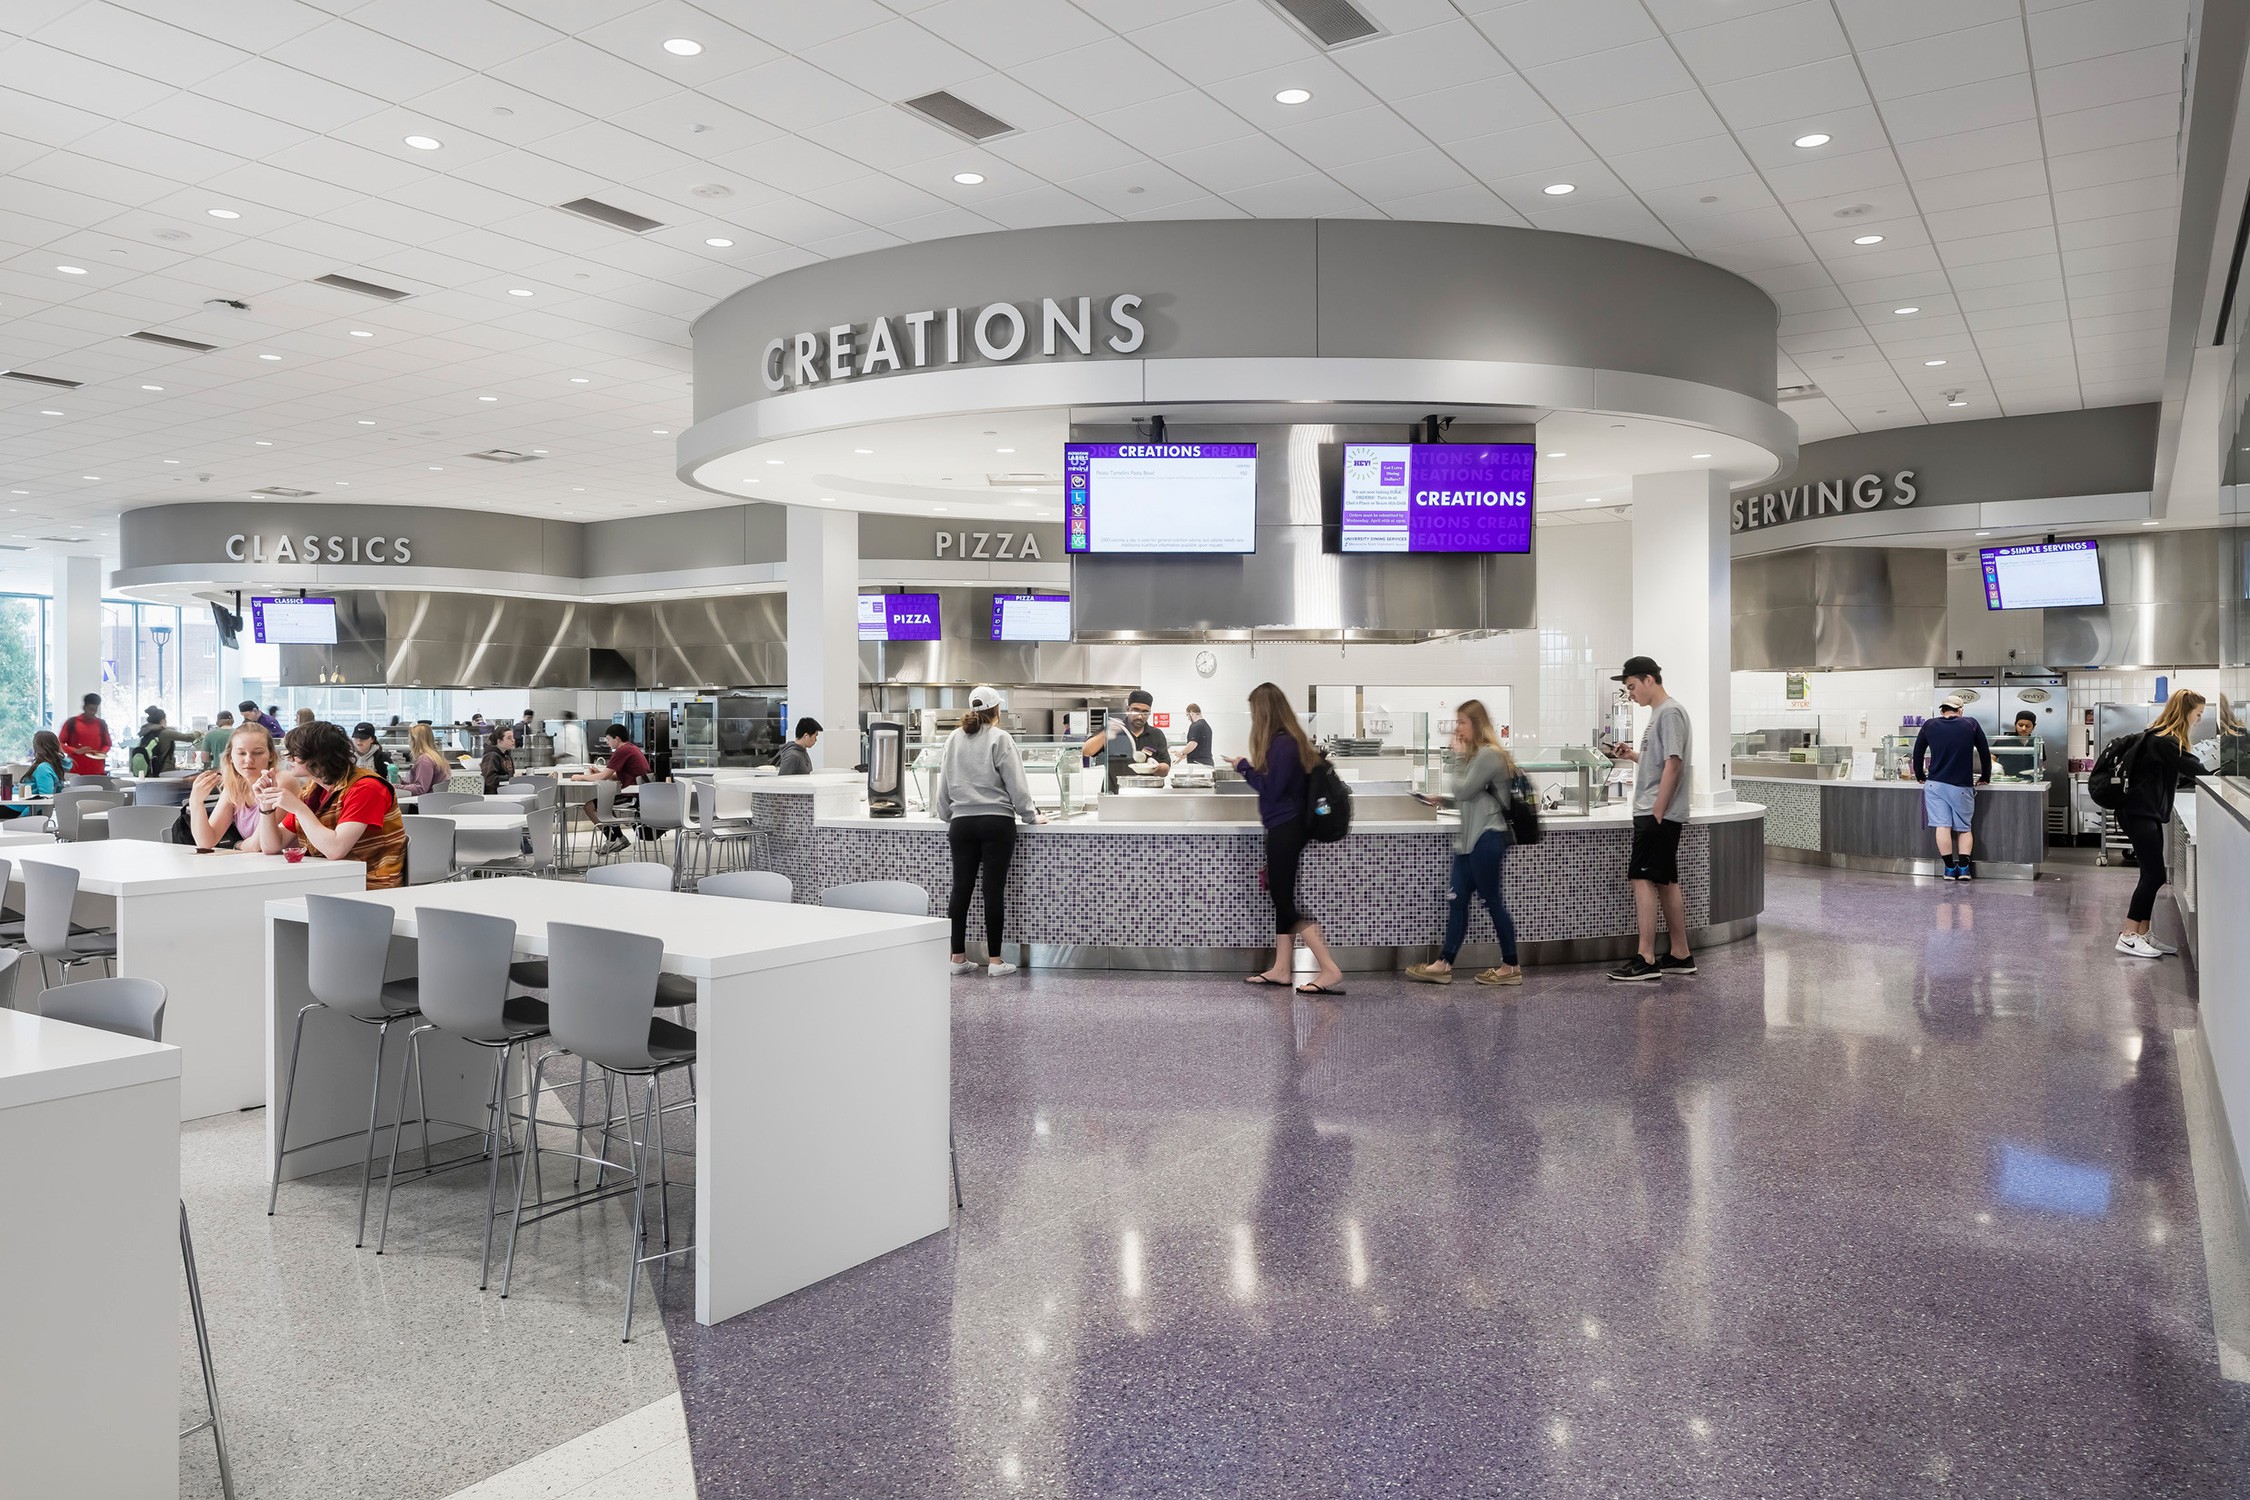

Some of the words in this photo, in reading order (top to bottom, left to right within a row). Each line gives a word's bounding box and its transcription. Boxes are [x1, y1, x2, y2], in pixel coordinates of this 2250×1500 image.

[761, 294, 1145, 392] CREATIONS
[1118, 445, 1201, 457] CREATIONS
[1202, 446, 1256, 457] CREATI
[1416, 491, 1527, 506] CREATIONS
[1732, 470, 1917, 530] SERVINGS
[225, 534, 411, 564] CLASSICS
[936, 531, 1041, 559] PIZZA
[2011, 545, 2040, 555] SIMPLE
[2043, 542, 2087, 552] SERVINGS
[893, 614, 932, 624] PIZZA
